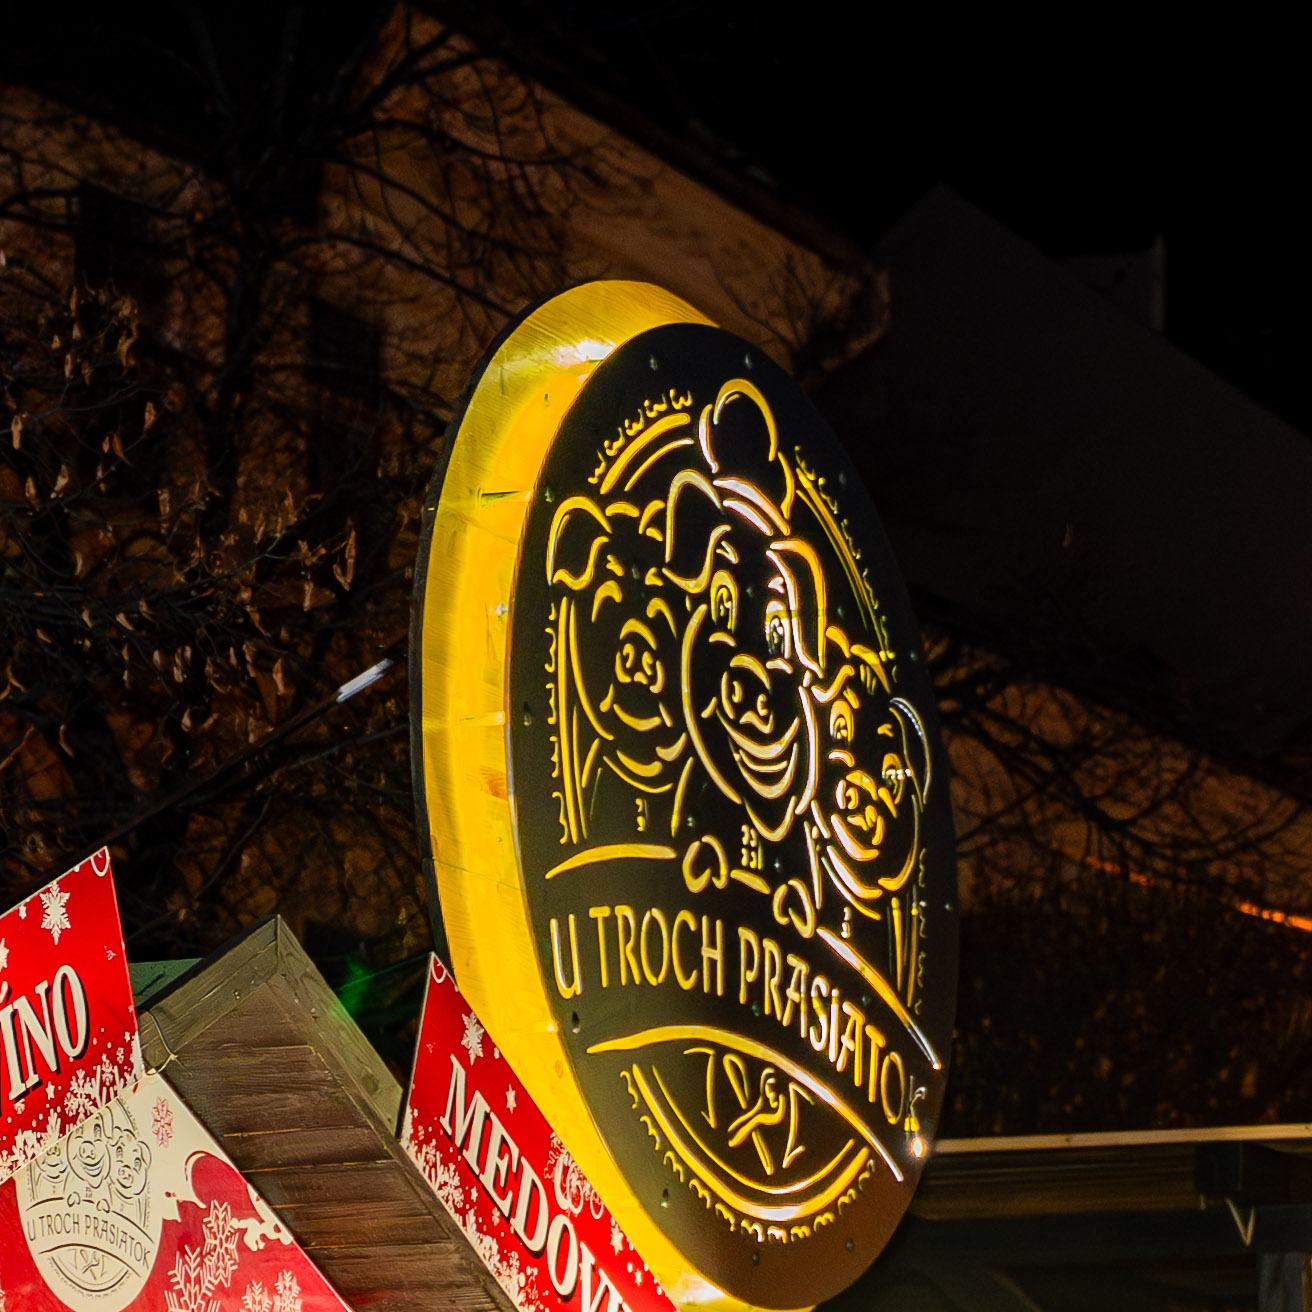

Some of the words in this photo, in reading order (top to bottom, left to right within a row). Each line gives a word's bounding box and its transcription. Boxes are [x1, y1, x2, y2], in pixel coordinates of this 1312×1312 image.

[549, 913, 582, 1000] U
[589, 905, 725, 997] TROCH
[27, 1219, 36, 1241] U
[39, 1213, 80, 1238] TROCH
[85, 1214, 151, 1271] PRASIATOK
